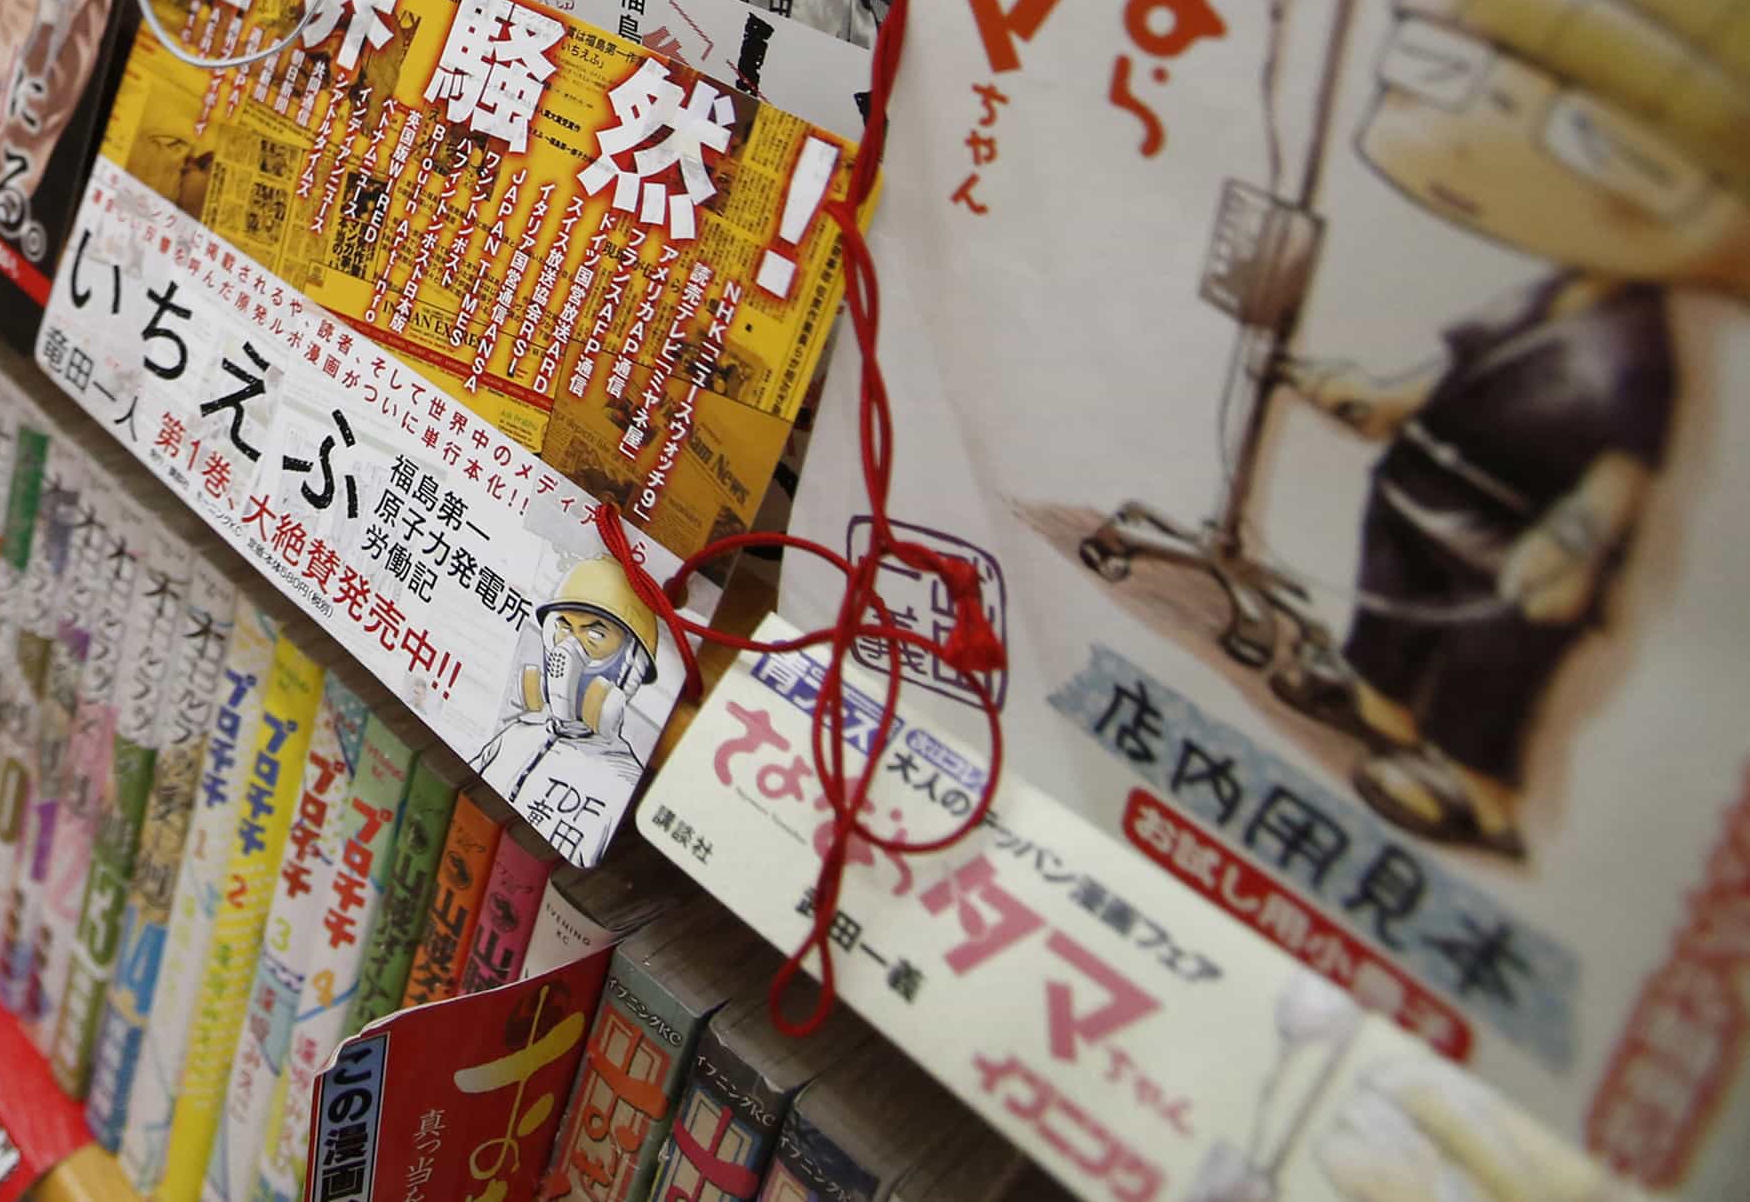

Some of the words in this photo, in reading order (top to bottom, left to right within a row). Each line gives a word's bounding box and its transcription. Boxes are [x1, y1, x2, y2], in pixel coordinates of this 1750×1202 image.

[364, 110, 422, 243] 英国版WIRED
[389, 138, 472, 334] ハフィントンポスト日本版
[442, 151, 500, 286] ワシントンポスト
[485, 169, 527, 257] JAPAN
[364, 220, 408, 322] Artinfo
[450, 259, 491, 346] TIMES
[465, 184, 555, 393] イタリア国営通信ANSA
[508, 196, 584, 373] スイス放送協会RSI
[534, 212, 616, 393] ドイツ国営放送ARD
[569, 228, 646, 398] フランスAFP通信
[607, 244, 679, 398] アメリカAP通信
[43, 324, 138, 442] 竜田一人
[71, 230, 358, 518] いちえふ
[154, 411, 463, 700] 第1巻、大絶賛発売中!!
[361, 524, 440, 605] 労働記
[374, 489, 533, 632] 原子力発電所
[389, 455, 491, 543] 福島第一
[546, 777, 605, 822] TDF
[651, 805, 714, 865] 講談社
[1094, 681, 1533, 1009] 店内用見本
[226, 875, 248, 910] 2
